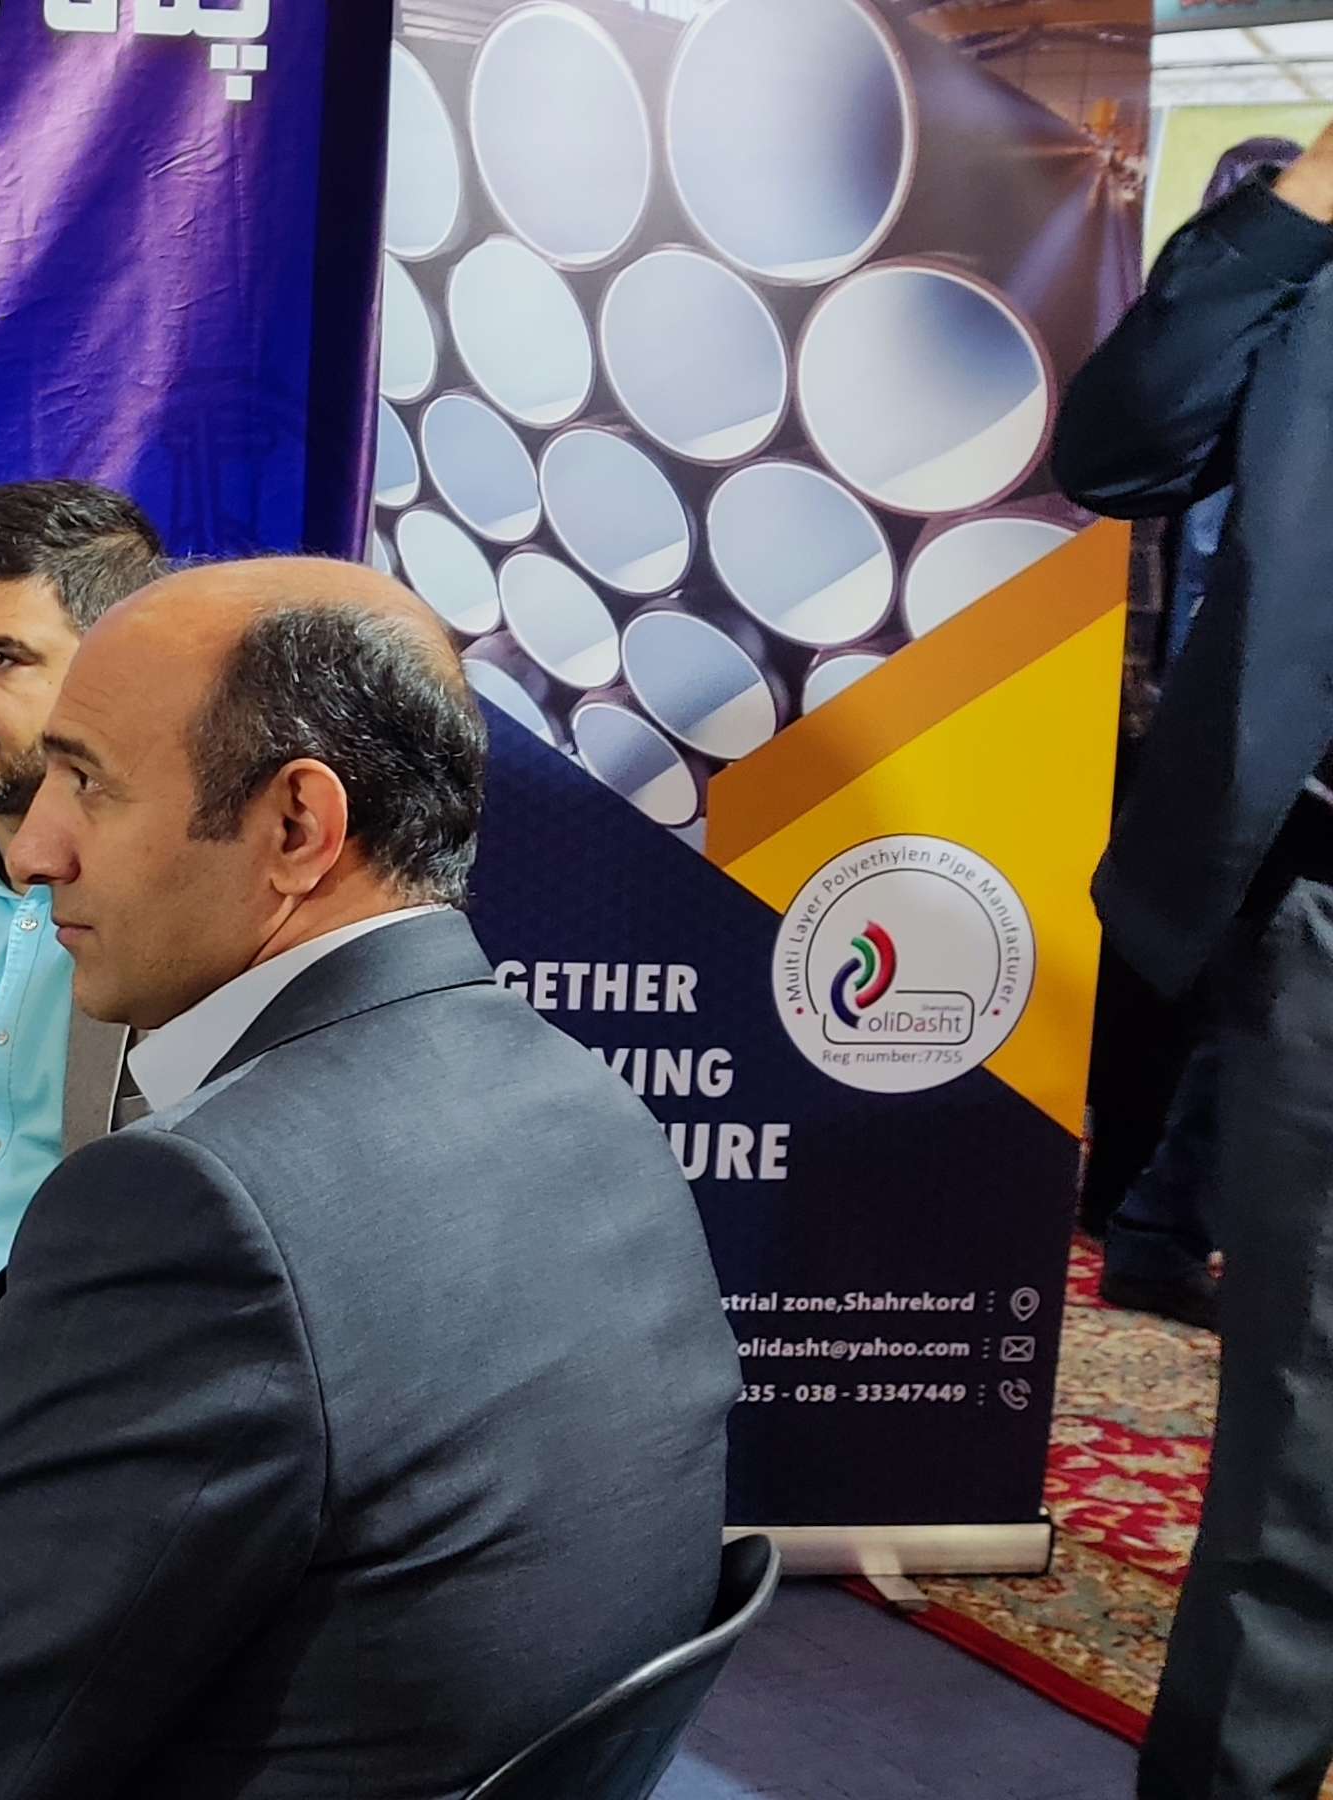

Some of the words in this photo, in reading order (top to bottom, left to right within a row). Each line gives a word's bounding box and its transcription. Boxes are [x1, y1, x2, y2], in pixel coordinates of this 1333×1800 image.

[822, 847, 931, 893] Polyethylen
[937, 852, 976, 881] Pipe
[790, 896, 823, 943] Layer
[979, 879, 1021, 1004] Manufacturer
[784, 951, 802, 1002] Multi
[822, 1050, 851, 1065] Reg
[856, 1049, 963, 1064] number:7755
[659, 1122, 791, 1181] URE
[783, 1292, 976, 1313] zone,Shahrekord
[737, 1337, 971, 1361] olidasht@yahoo.com
[795, 1384, 837, 1402] 038
[855, 1384, 967, 1402] 33347449
